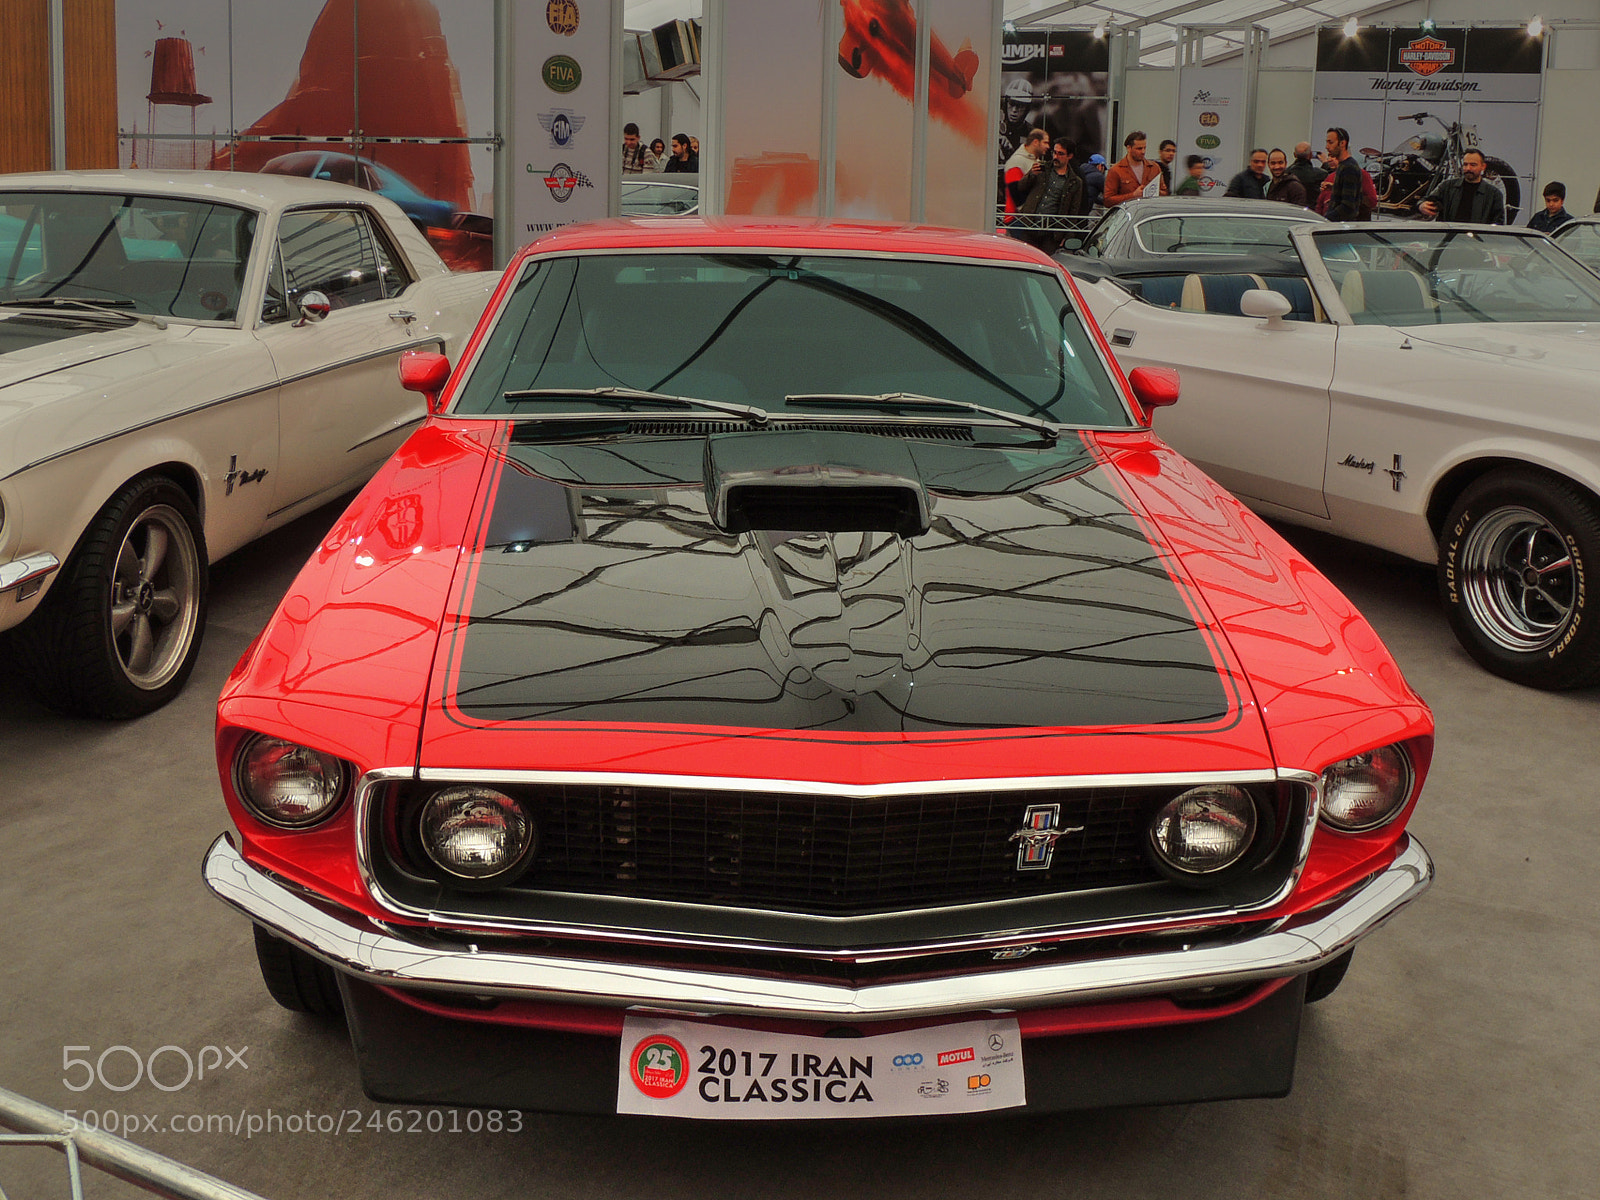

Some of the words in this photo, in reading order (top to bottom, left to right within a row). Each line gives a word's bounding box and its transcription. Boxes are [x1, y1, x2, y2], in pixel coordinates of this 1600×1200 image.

[549, 65, 575, 81] FIVA
[1368, 78, 1482, 95] Harley-Davidson
[554, 120, 570, 140] FIM
[1446, 539, 1461, 604] RADIAL
[1565, 534, 1586, 609] COOPER
[1547, 613, 1582, 659] COBRA
[697, 1045, 779, 1077] 2017
[791, 1053, 874, 1079] IRAN
[940, 1050, 973, 1064] MOTUL
[644, 1080, 674, 1089] CLASSICA
[698, 1076, 874, 1103] CLASSICA
